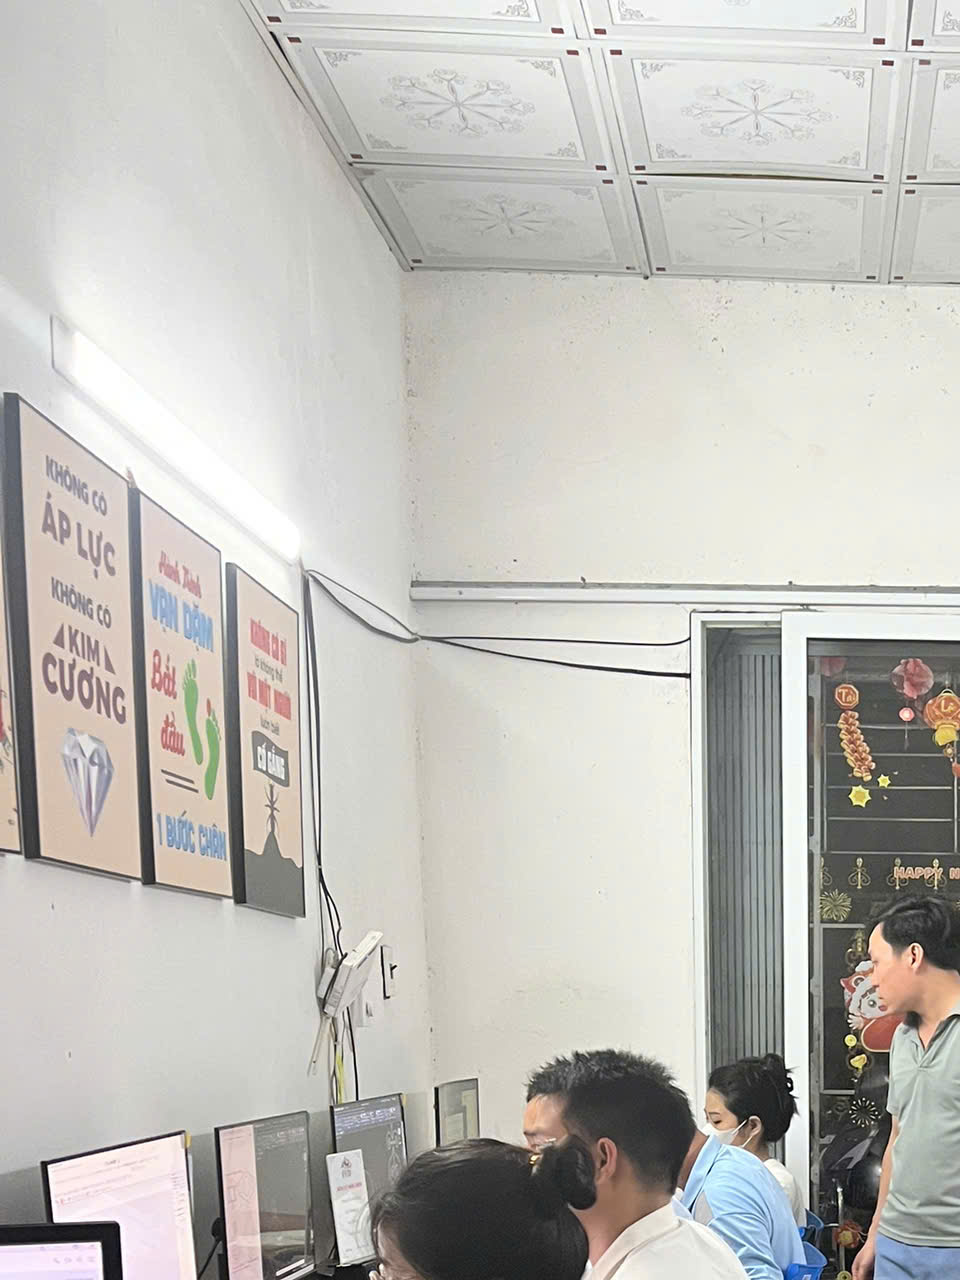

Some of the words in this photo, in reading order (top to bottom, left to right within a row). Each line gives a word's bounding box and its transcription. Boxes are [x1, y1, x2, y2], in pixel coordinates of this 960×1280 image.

[45, 454, 89, 505] KHÔNG
[92, 490, 108, 516] CÓ
[41, 491, 72, 546] ÁP
[76, 521, 116, 580] LỰC
[51, 576, 94, 620] KHÔNG
[96, 603, 112, 629] CÓ
[148, 578, 179, 634] VẠN
[183, 601, 214, 653] DẶM
[68, 624, 101, 668] KIM
[42, 652, 127, 725] CƯƠNG
[151, 649, 177, 700] Bắt
[161, 711, 185, 756] đầu
[156, 812, 163, 846] 1
[165, 809, 196, 854] BƯỚC
[198, 823, 227, 862] CHÂN
[893, 866, 943, 880] HAPPY
